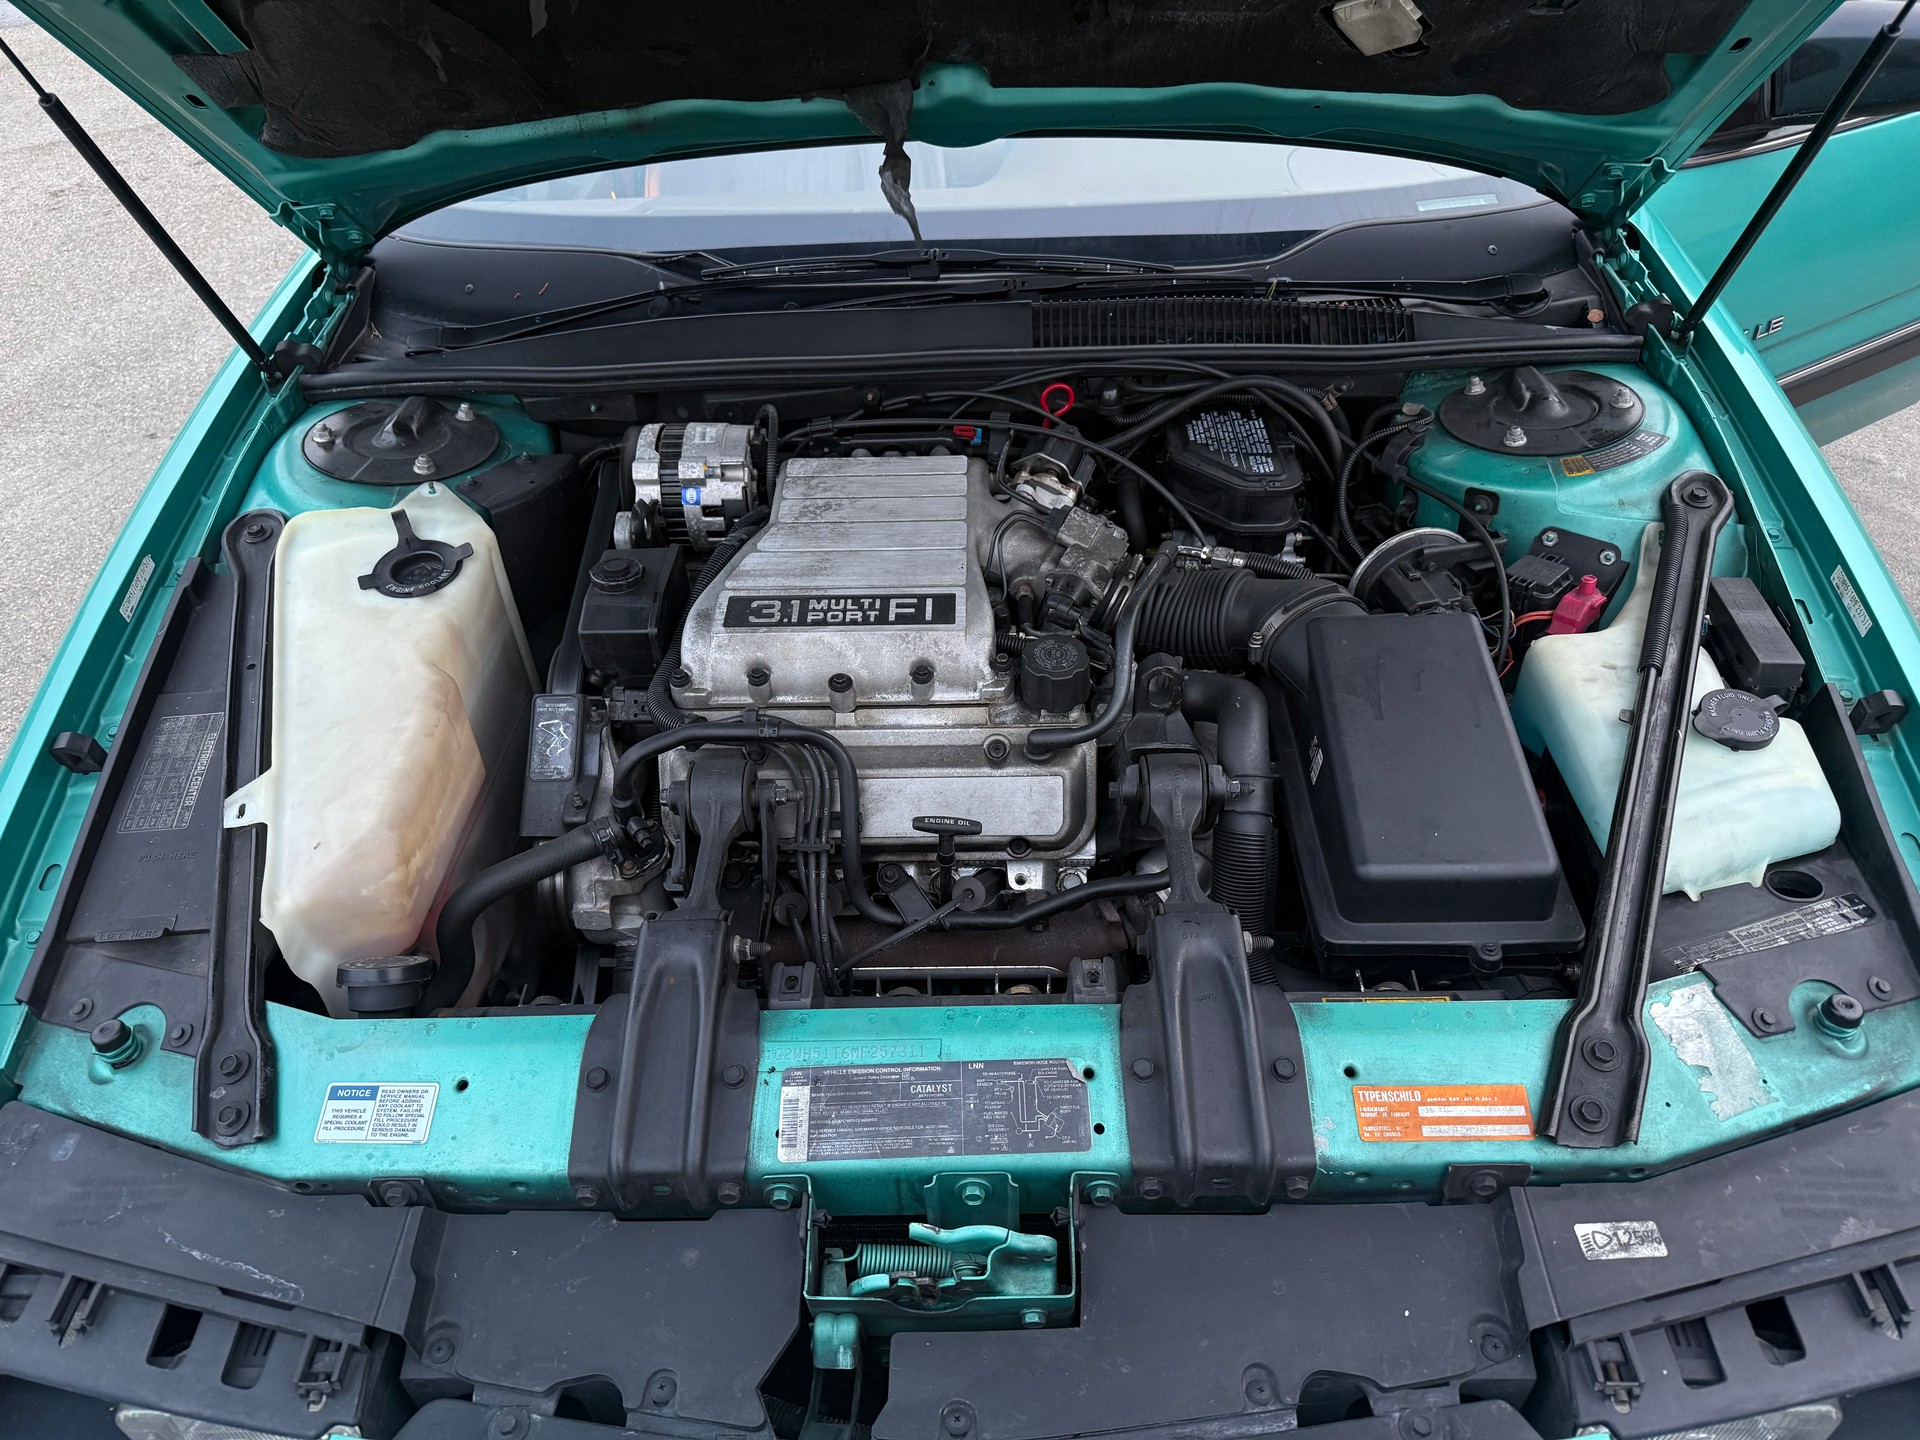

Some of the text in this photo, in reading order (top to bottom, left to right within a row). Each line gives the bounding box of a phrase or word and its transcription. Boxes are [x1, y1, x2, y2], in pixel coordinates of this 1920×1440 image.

[1753, 315, 1786, 340] LE
[386, 568, 451, 594] ENGINE COOLANT
[748, 597, 933, 623] 3.1 MULTI PORT FI
[1737, 693, 1755, 703] ONLY
[183, 732, 217, 806] ELECTRICAL CENTER
[924, 817, 971, 827] ENGINE OIL
[138, 851, 197, 862] PUSH HERE
[130, 929, 160, 939] HERE
[1736, 927, 1764, 942] Delco
[1762, 916, 1805, 934] Freedom
[968, 1062, 984, 1070] LNN
[337, 1089, 371, 1097] NOTICE
[910, 1083, 953, 1094] CATALYST
[1357, 1090, 1422, 1102] TYPENSCHILD
